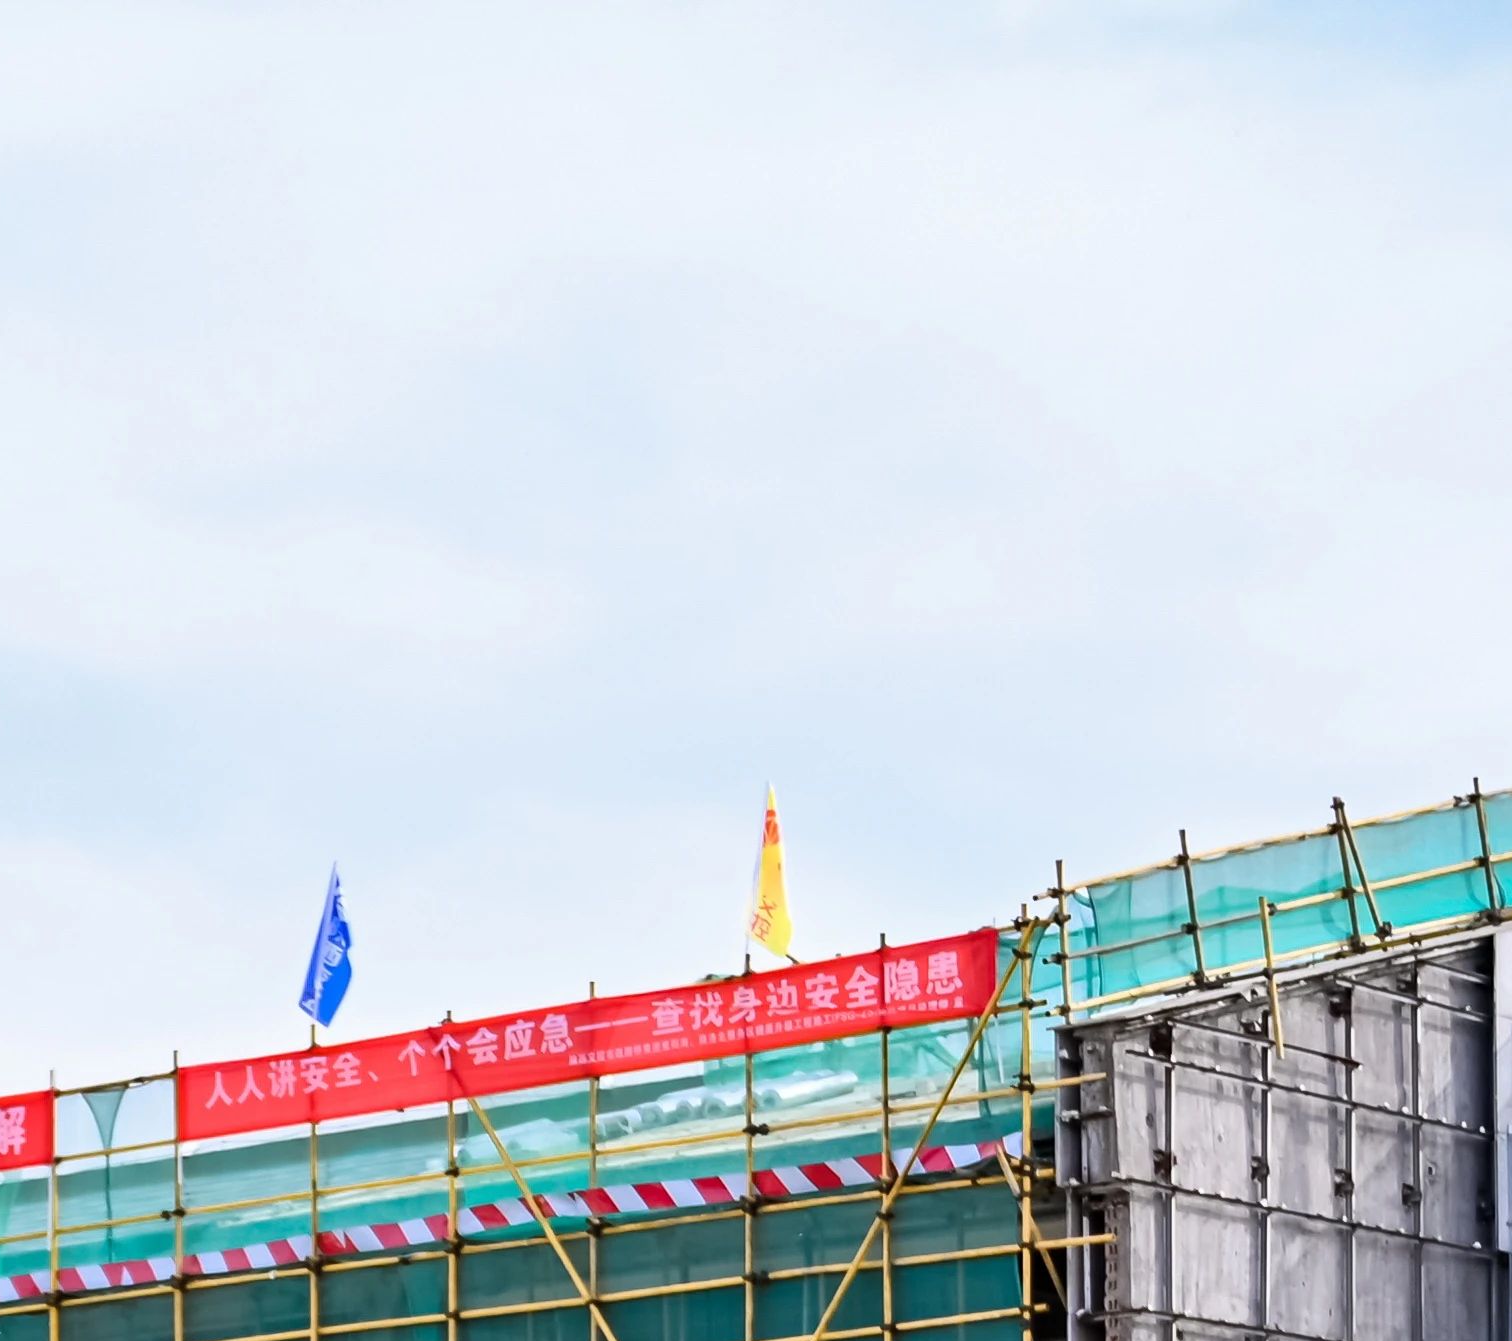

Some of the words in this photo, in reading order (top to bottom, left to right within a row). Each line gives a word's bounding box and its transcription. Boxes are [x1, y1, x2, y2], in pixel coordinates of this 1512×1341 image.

[204, 948, 965, 1111] 人人讲安全、个个会应急——查找身边安全隐患
